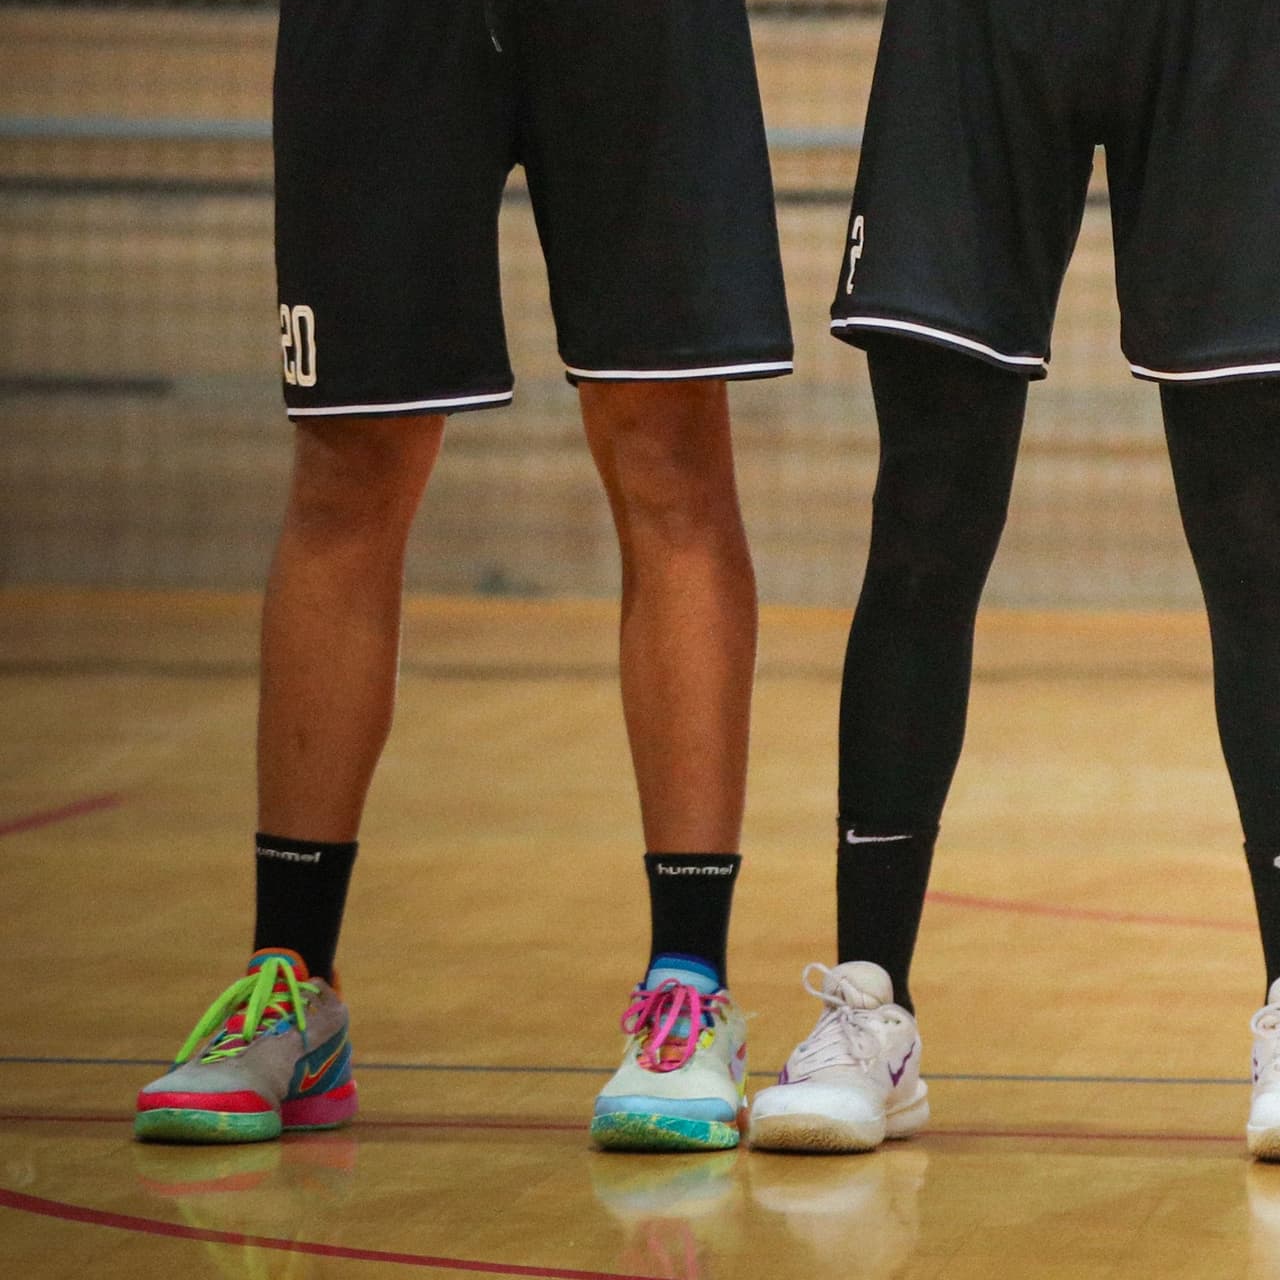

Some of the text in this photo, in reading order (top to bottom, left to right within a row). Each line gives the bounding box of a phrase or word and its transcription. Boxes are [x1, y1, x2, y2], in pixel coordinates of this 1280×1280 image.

[280, 303, 317, 387] 20
[257, 846, 321, 862] ummel
[658, 863, 734, 875] hummel
